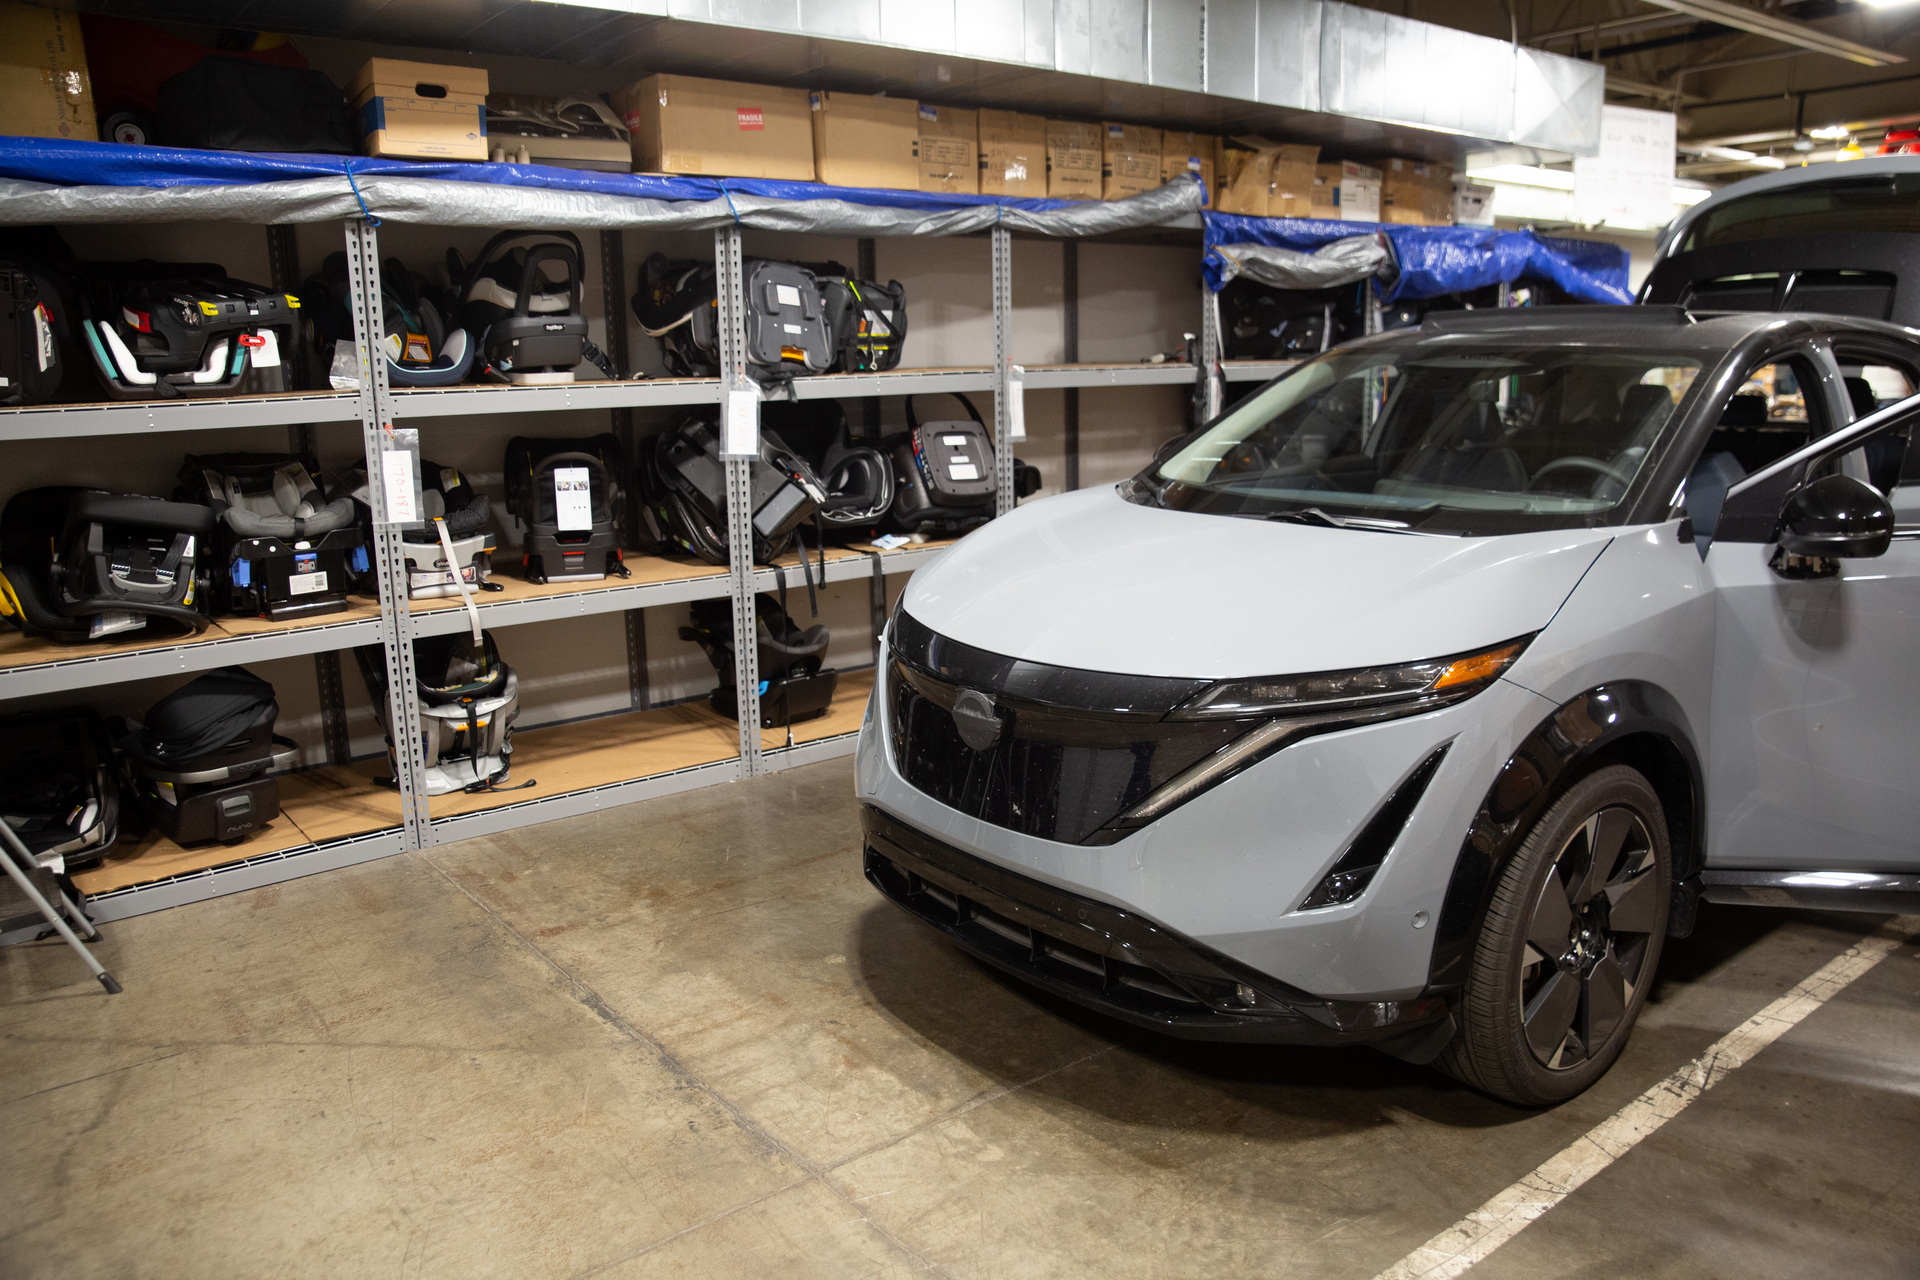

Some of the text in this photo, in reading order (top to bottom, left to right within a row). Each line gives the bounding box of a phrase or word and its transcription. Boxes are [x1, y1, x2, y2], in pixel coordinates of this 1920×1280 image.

[738, 114, 763, 122] FRAGILE
[391, 463, 410, 517] 170-187
[227, 822, 253, 833] nuna
